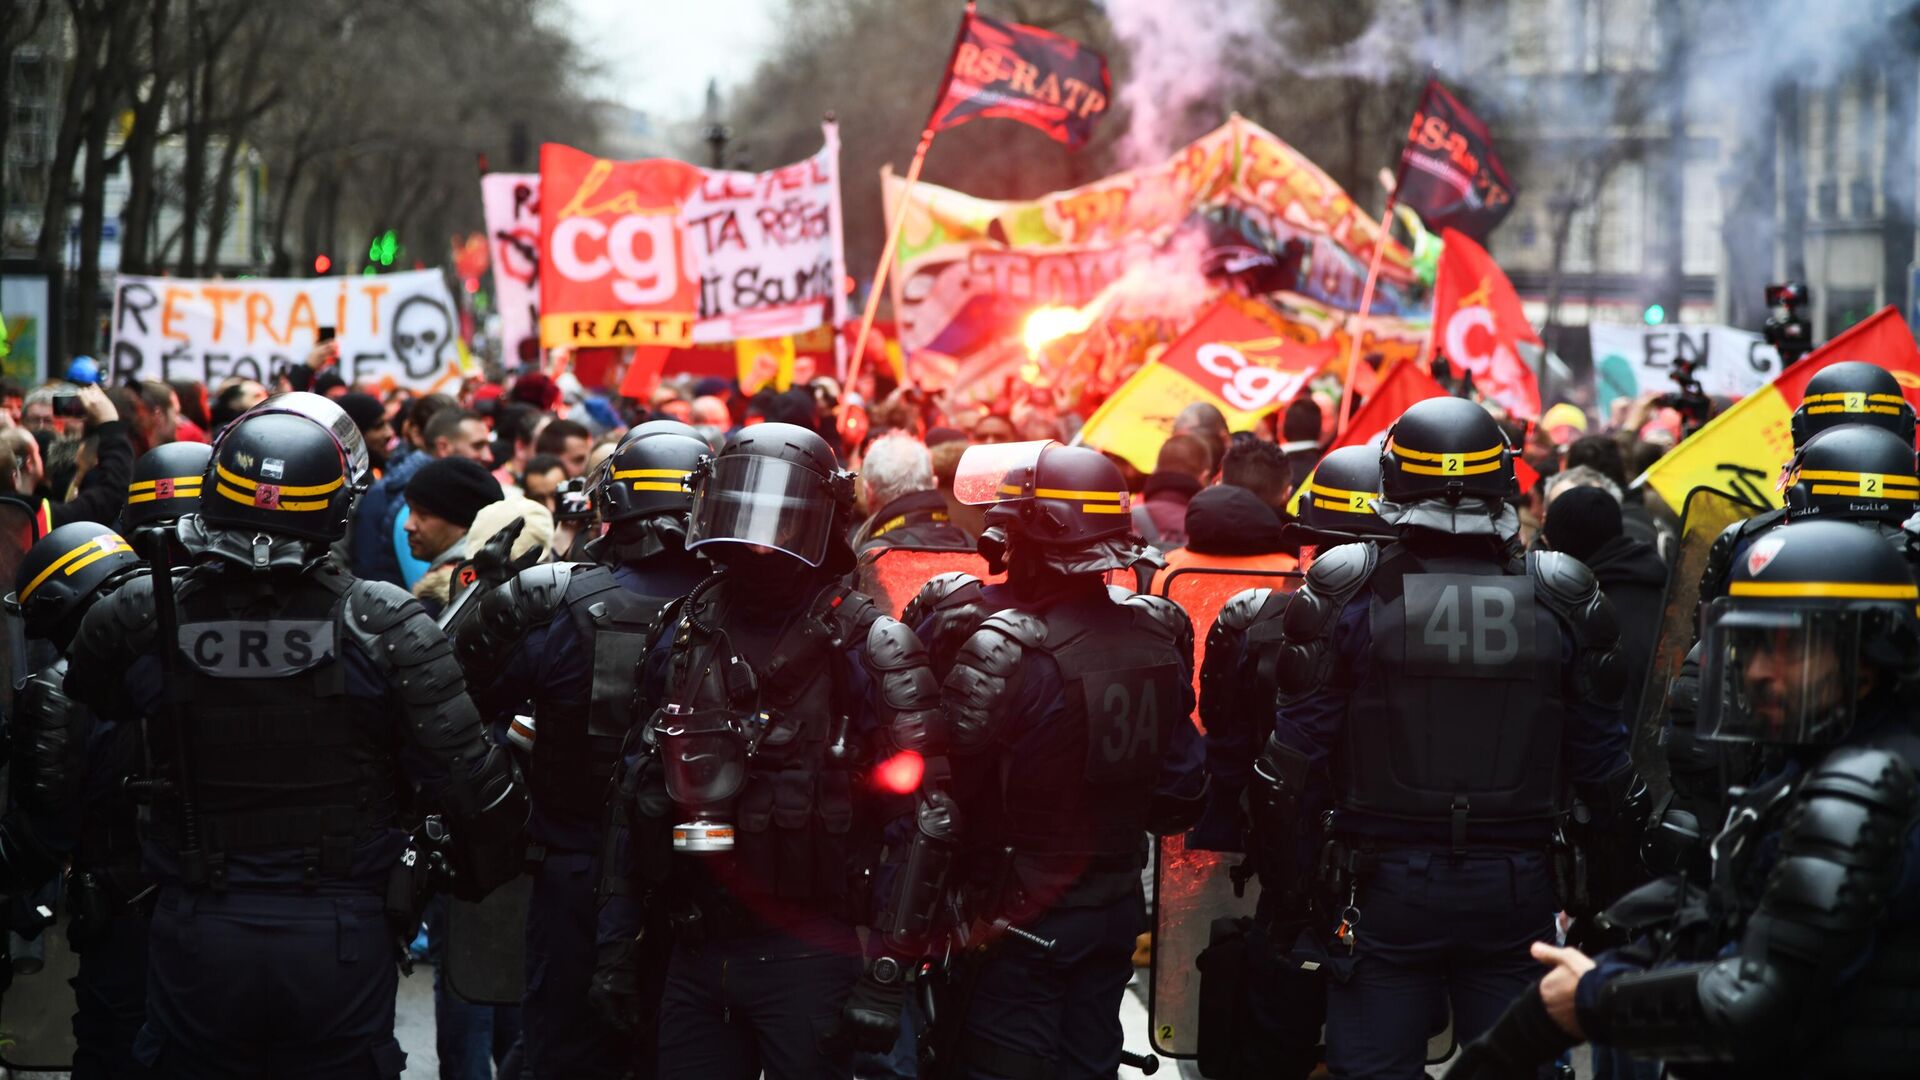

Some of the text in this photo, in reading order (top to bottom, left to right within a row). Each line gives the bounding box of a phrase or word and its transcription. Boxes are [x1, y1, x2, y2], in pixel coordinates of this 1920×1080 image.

[558, 160, 682, 219] La
[1850, 397, 1859, 409] 2
[1448, 459, 1457, 472] 2
[1866, 479, 1876, 493] 2
[1355, 496, 1364, 509] 2
[1423, 584, 1519, 665] 4B
[193, 629, 313, 668] CRS
[1103, 678, 1159, 763] 3A
[1162, 1025, 1173, 1040] 2
